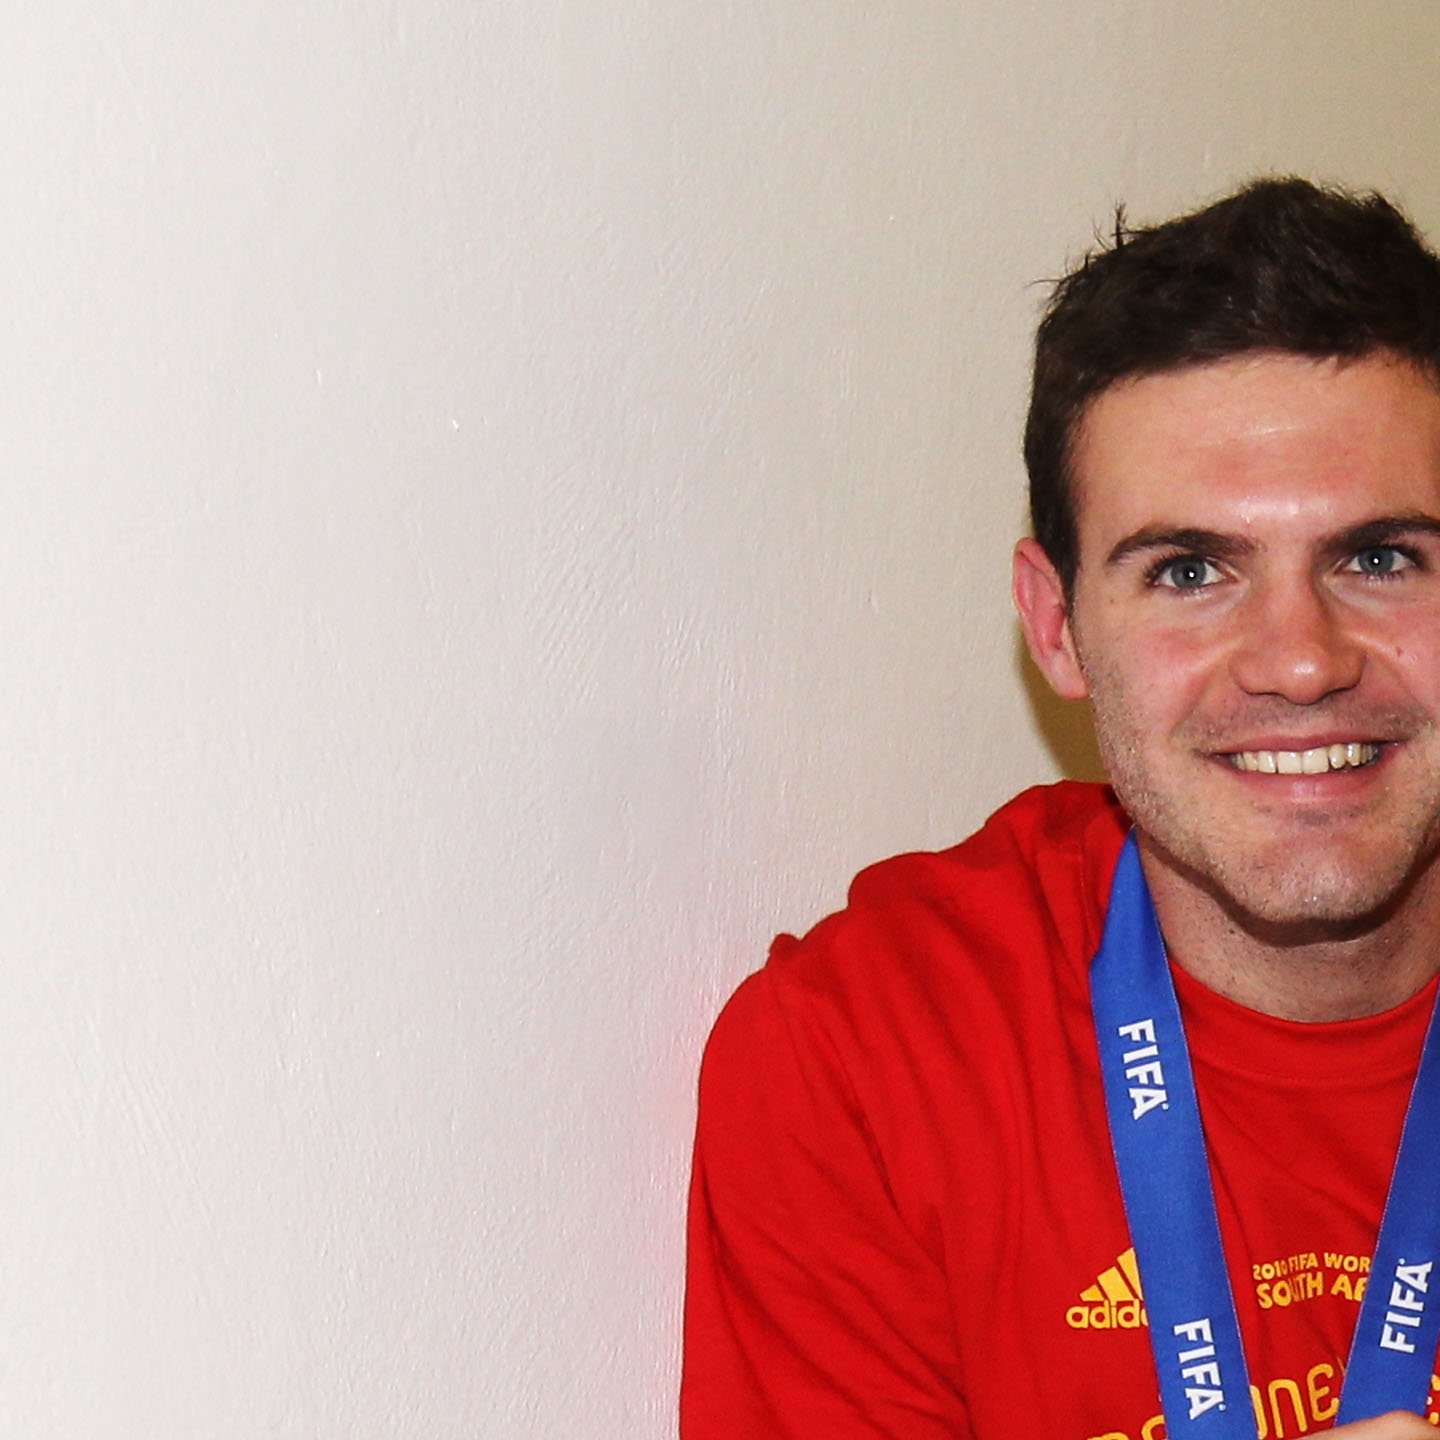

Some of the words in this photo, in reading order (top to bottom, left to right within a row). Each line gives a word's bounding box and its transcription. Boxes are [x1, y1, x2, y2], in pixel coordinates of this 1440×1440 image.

[1119, 1019, 1167, 1120] FIFA
[1256, 1271, 1324, 1309] SOUTH
[1288, 1252, 1319, 1273] FIFA
[1323, 1252, 1372, 1273] WOR
[1066, 1299, 1148, 1329] adid
[1380, 1262, 1433, 1353] FIFA
[1174, 1318, 1224, 1420] FIFA
